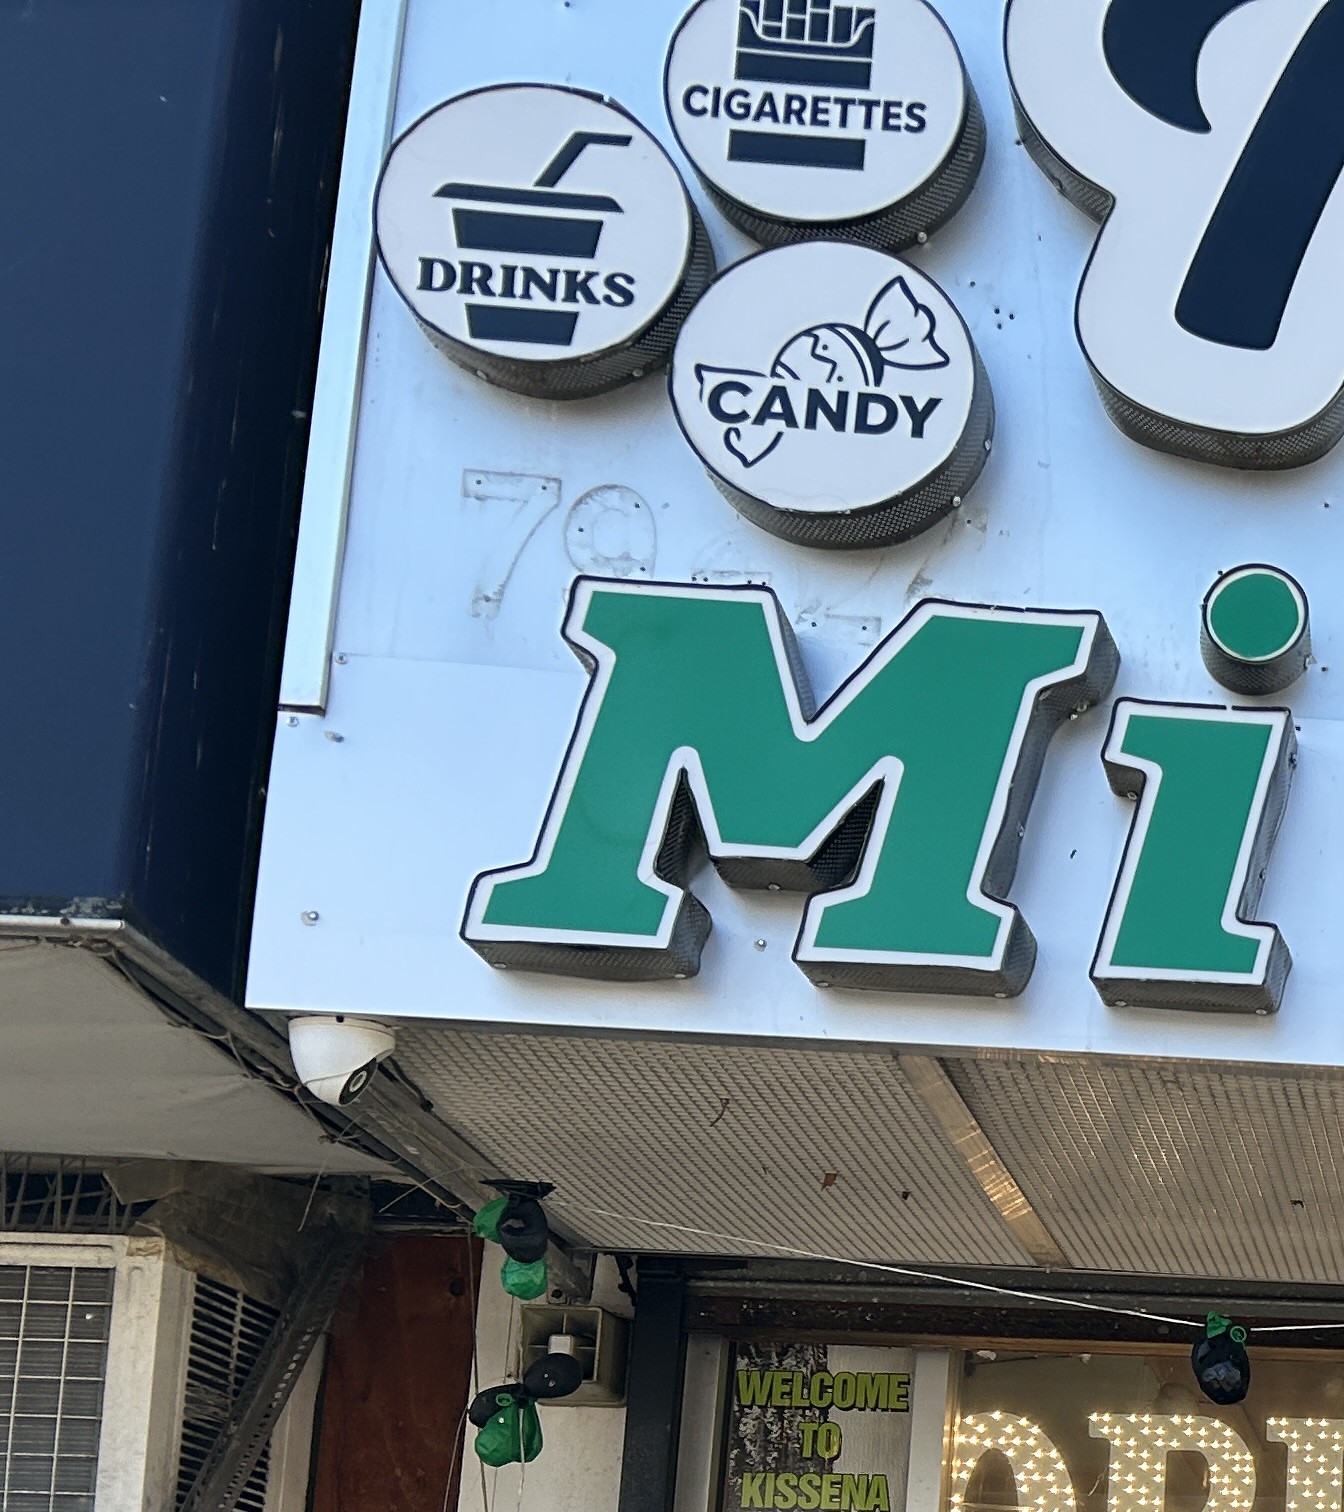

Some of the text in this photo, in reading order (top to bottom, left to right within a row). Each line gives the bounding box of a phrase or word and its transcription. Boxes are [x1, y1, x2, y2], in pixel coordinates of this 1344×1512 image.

[682, 84, 927, 134] CIGARETTES
[417, 256, 636, 308] DRINKS
[707, 381, 943, 439] CANDY
[737, 1369, 910, 1412] WELCOME
[799, 1421, 843, 1459] TO
